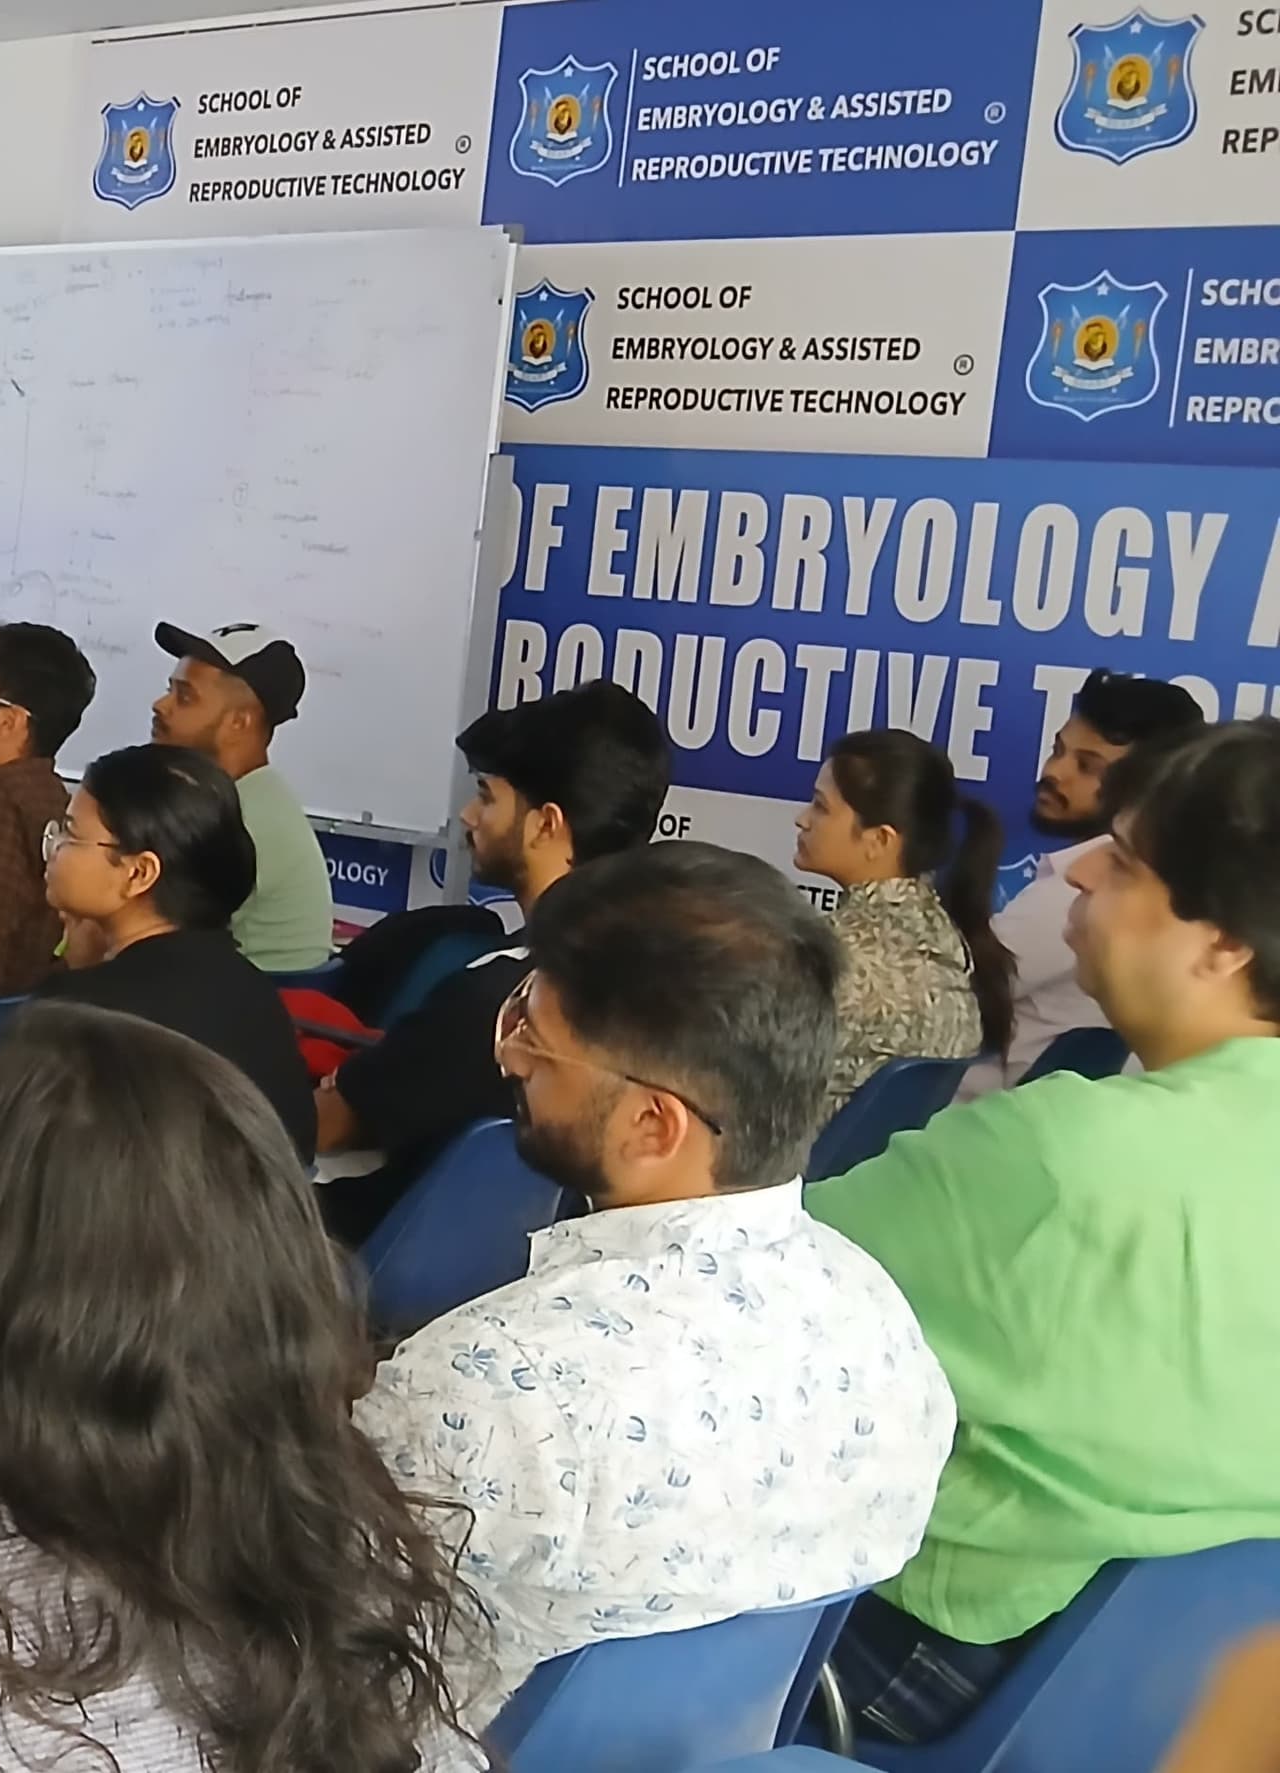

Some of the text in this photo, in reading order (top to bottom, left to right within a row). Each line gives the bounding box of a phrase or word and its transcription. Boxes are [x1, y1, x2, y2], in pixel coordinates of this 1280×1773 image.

[1237, 8, 1280, 37] SC
[642, 46, 781, 81] SCHOOL OF
[1230, 67, 1280, 96] EM
[197, 86, 302, 115] SCHOOL OF
[637, 88, 952, 131] EMBRYOLOGY & ASSISTED
[193, 123, 432, 159] EMBRYOLOGY & ASSISTED
[631, 139, 999, 182] REPRODUCTIVE TECHNOLOGY
[189, 167, 466, 203] REPRODUCTIVE TECHNOLOGY
[616, 285, 753, 310] SCHOOL OF
[611, 336, 921, 361] EMBRYOLOGY & ASSISTED
[1193, 337, 1280, 365] EMBR
[606, 386, 967, 416] REPRODUCTIVE TECHNOLOGY
[587, 485, 1230, 642] EMBRYOLOGY
[658, 814, 692, 839] OF
